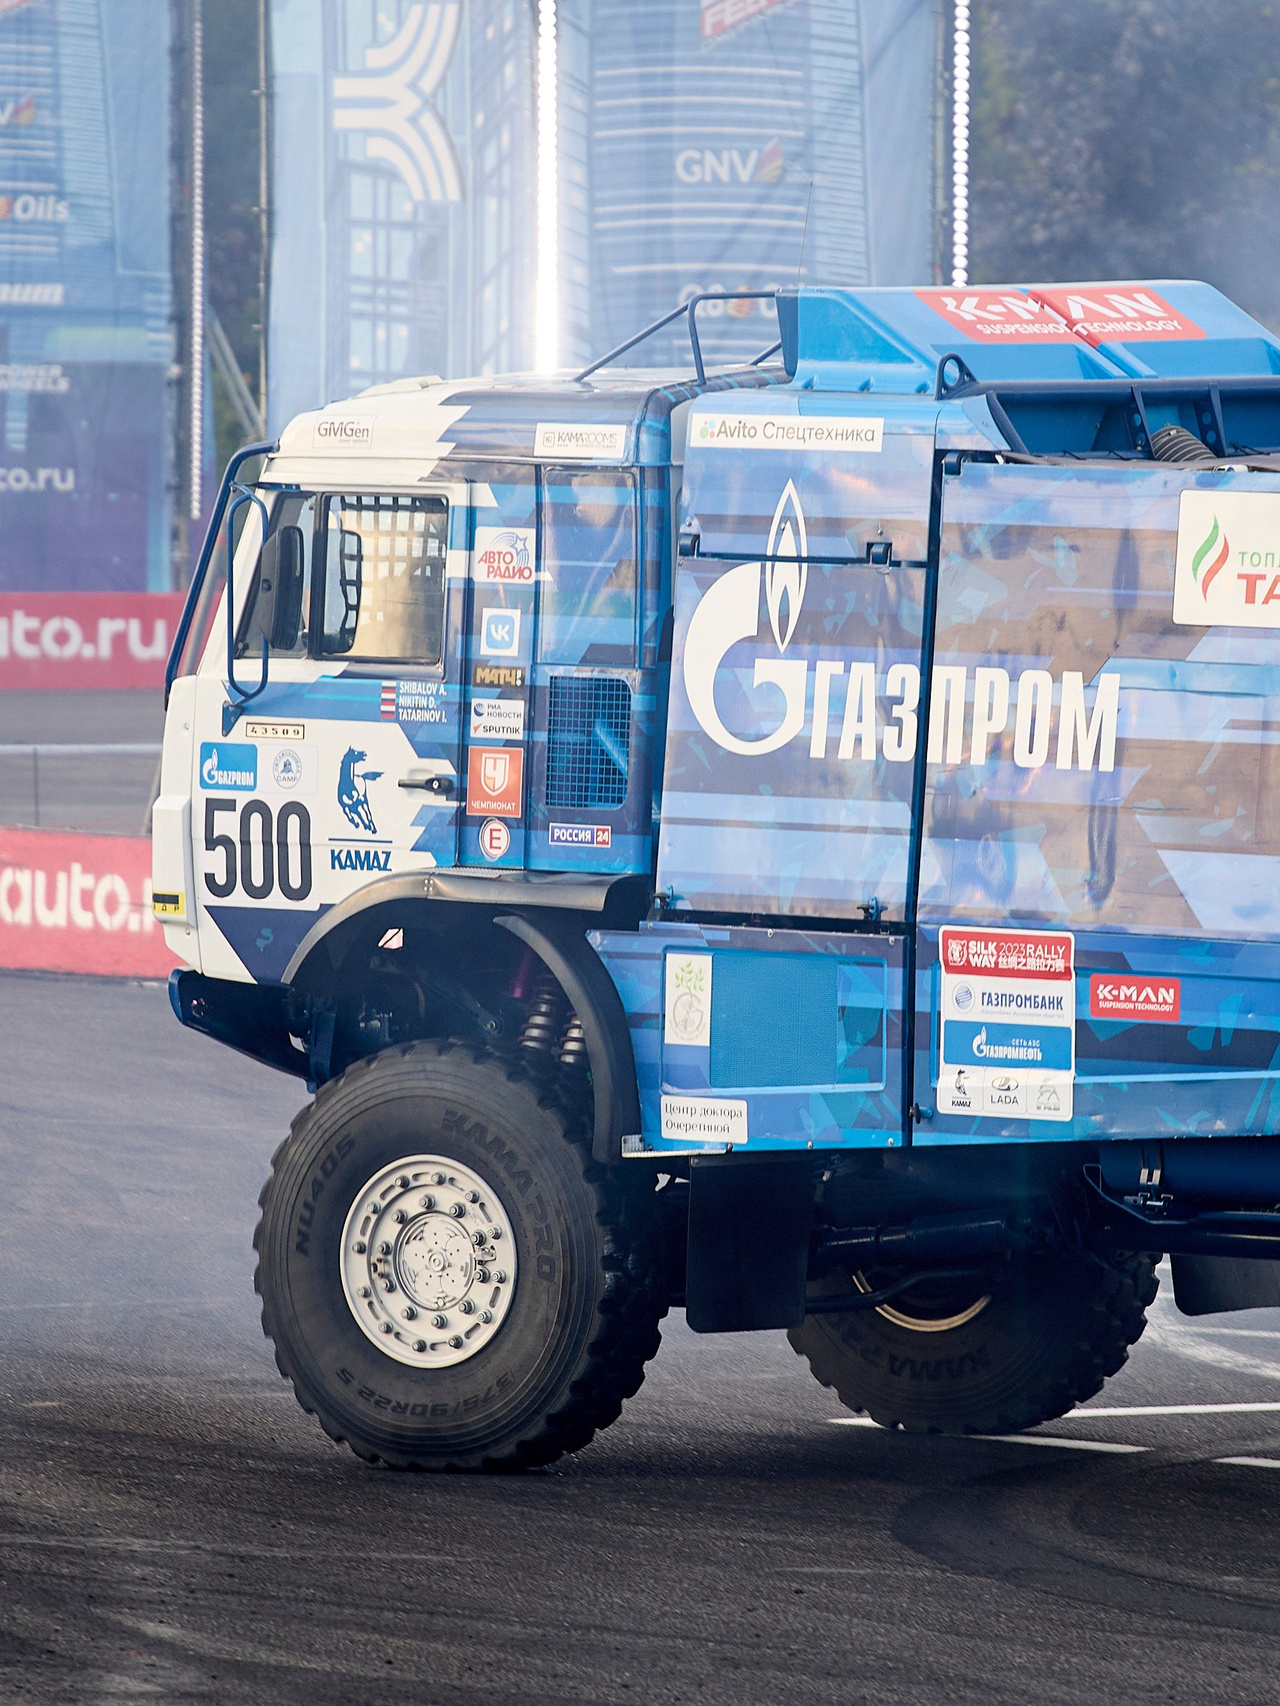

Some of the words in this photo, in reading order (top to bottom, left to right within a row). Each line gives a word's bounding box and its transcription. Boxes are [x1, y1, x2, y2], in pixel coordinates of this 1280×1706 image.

[675, 150, 758, 182] GNV
[15, 194, 71, 221] Oils
[1072, 320, 1184, 336] TECHNOLOGY
[318, 421, 369, 438] GMGen
[557, 432, 617, 444] KAMAROOMS
[716, 420, 757, 439] Avito
[762, 421, 875, 443] Спецтехника
[0, 467, 75, 491] o.ru
[478, 551, 514, 565] АВТО
[486, 565, 533, 580] РАДИО
[0, 610, 168, 661] to.ru
[490, 623, 510, 642] VK
[476, 667, 521, 686] МАТЧ!
[400, 681, 438, 695] SHIBALOV
[439, 684, 447, 696] A.
[399, 695, 427, 708] NIKITIN
[429, 696, 437, 709] D.
[399, 709, 441, 722] TATARINOV
[442, 710, 447, 723] I.
[810, 660, 1121, 772] ГАЗПРОМ
[218, 771, 254, 786] GAZPROM
[471, 801, 516, 811] ЧЕМПИОНАТ
[489, 828, 502, 849] E
[554, 828, 591, 841] РОССИЯ
[596, 831, 608, 841] 24
[204, 797, 312, 901] 500
[330, 849, 392, 871] KAMAZ
[969, 940, 997, 954] SILK
[999, 942, 1025, 956] 2023
[1026, 944, 1065, 959] RALLY
[969, 954, 998, 968] WAY
[981, 992, 1064, 1010] ГАЗПРОМБАНК
[1097, 984, 1174, 1003] K-MAN
[1099, 1000, 1134, 1009] SUSPENSION
[1135, 1002, 1174, 1012] TECHNOLOGY
[1011, 1038, 1027, 1046] СЕТЬ
[1028, 1039, 1040, 1047] АЗС
[986, 1045, 1042, 1061] ГАЗПРОМНЕФТЬ
[990, 1095, 1019, 1105] LADA
[665, 1103, 697, 1118] Центр
[699, 1107, 743, 1120] доктора
[666, 1120, 730, 1135] Очеретиной
[526, 1195, 556, 1283] PRO
